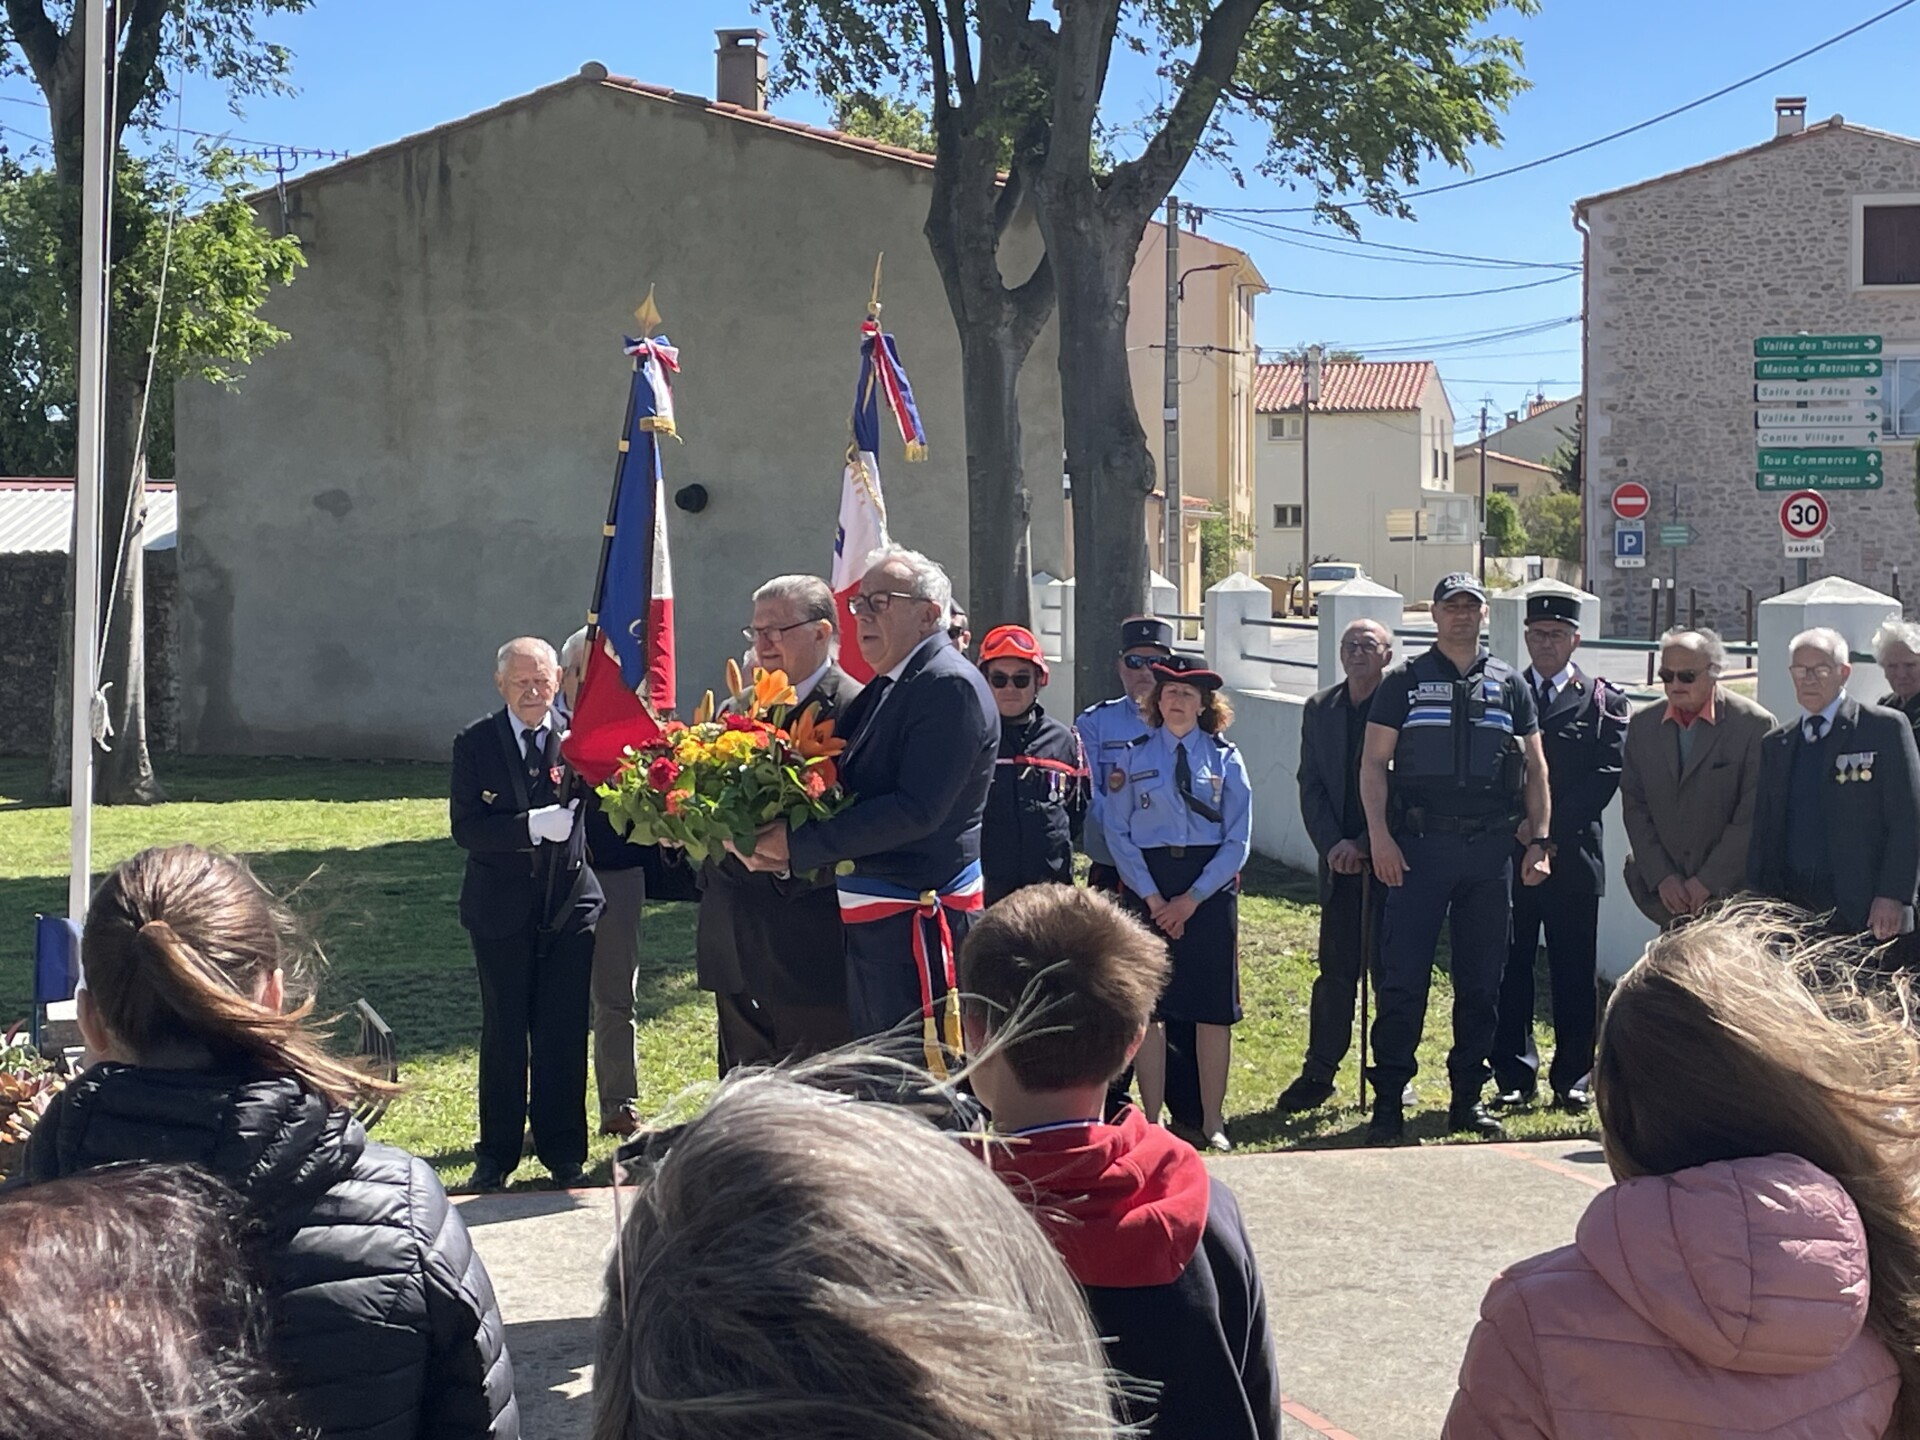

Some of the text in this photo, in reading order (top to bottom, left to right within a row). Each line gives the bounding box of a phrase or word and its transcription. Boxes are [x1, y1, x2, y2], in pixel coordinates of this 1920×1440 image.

[1763, 340, 1860, 352] Vallée des Tortues
[1763, 363, 1861, 374] Maison de Retraite
[1761, 385, 1851, 396] Salle des Fêtes
[1761, 412, 1853, 423] Vallée Heureuse
[1761, 432, 1845, 443] Centre Village
[1763, 455, 1857, 466] Tous Commerces
[1779, 474, 1806, 485] Hôtel
[1821, 474, 1861, 486] Jacques
[1790, 504, 1820, 526] 30
[1624, 535, 1637, 552] P
[1788, 545, 1822, 554] RAPPEL
[1419, 684, 1450, 694] POLICE
